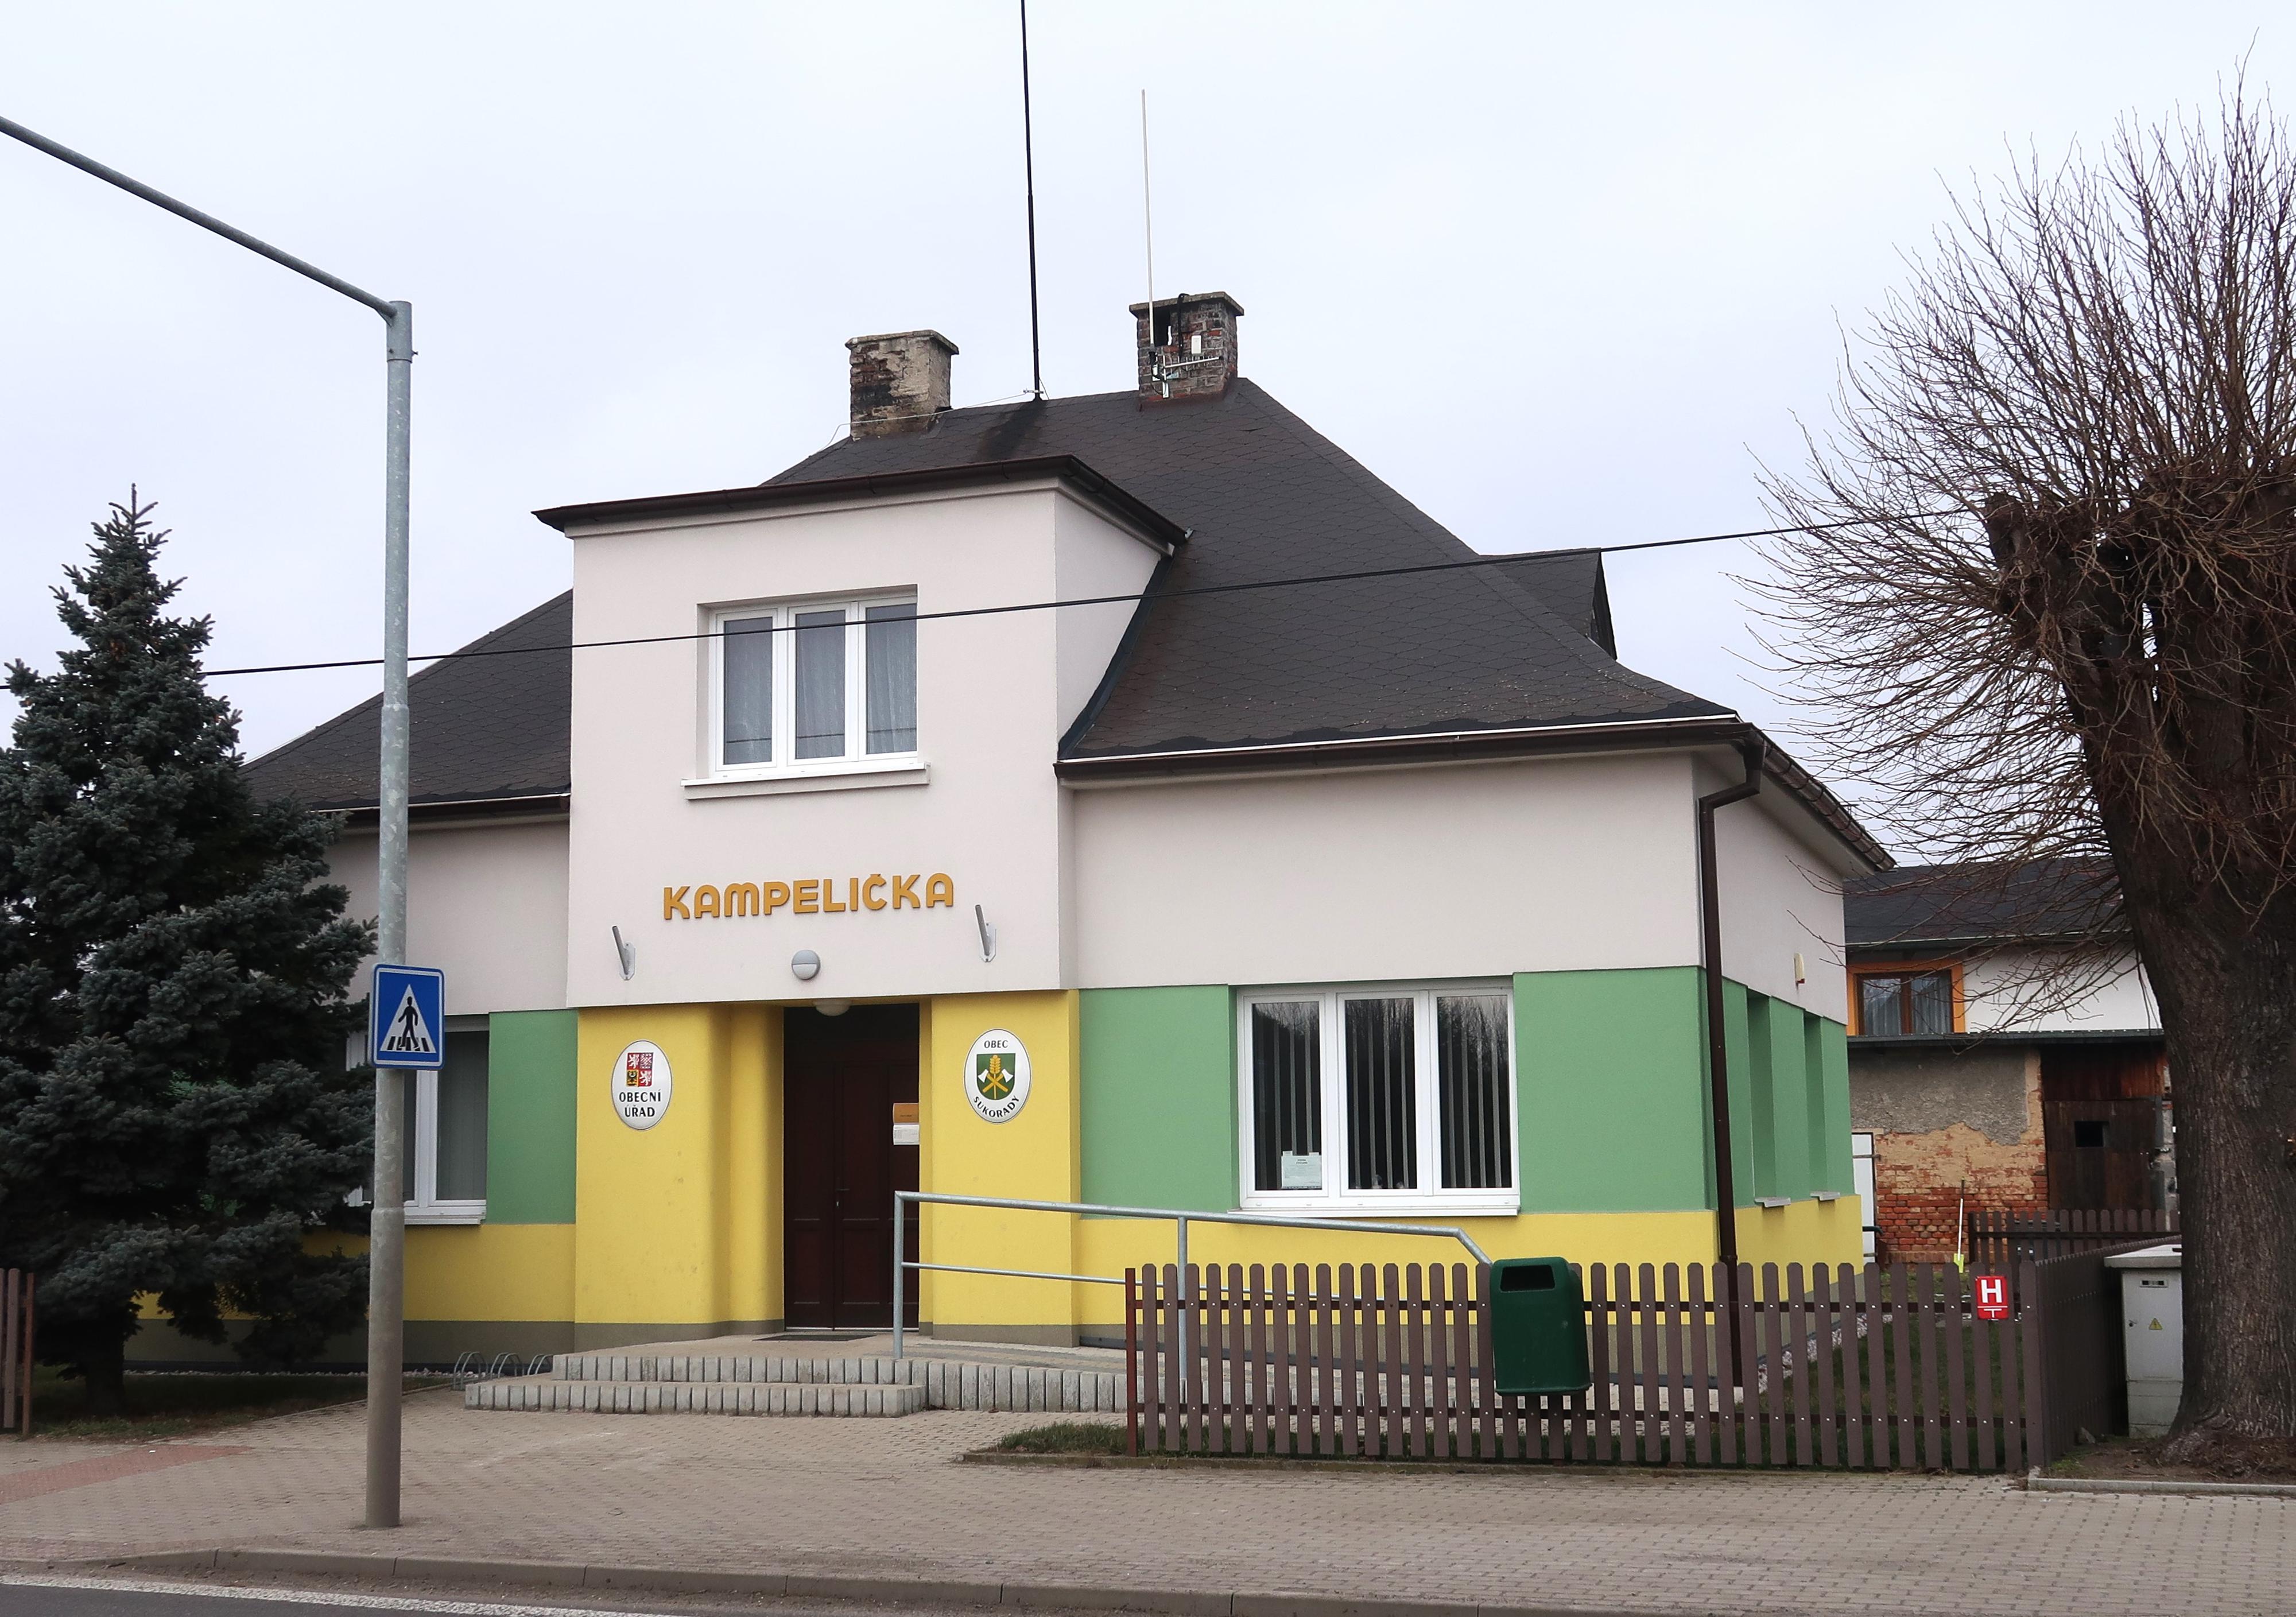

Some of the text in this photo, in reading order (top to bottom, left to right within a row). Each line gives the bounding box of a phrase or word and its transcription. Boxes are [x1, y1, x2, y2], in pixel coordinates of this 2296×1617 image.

[664, 873, 953, 920] KAMPELIČKA
[984, 1040, 1009, 1049] OBEC
[619, 1089, 661, 1103] OBECNÍ
[625, 1104, 655, 1117] ÚŘAD
[973, 1096, 1019, 1118] SUKORADY
[1981, 1279, 2002, 1303] H
